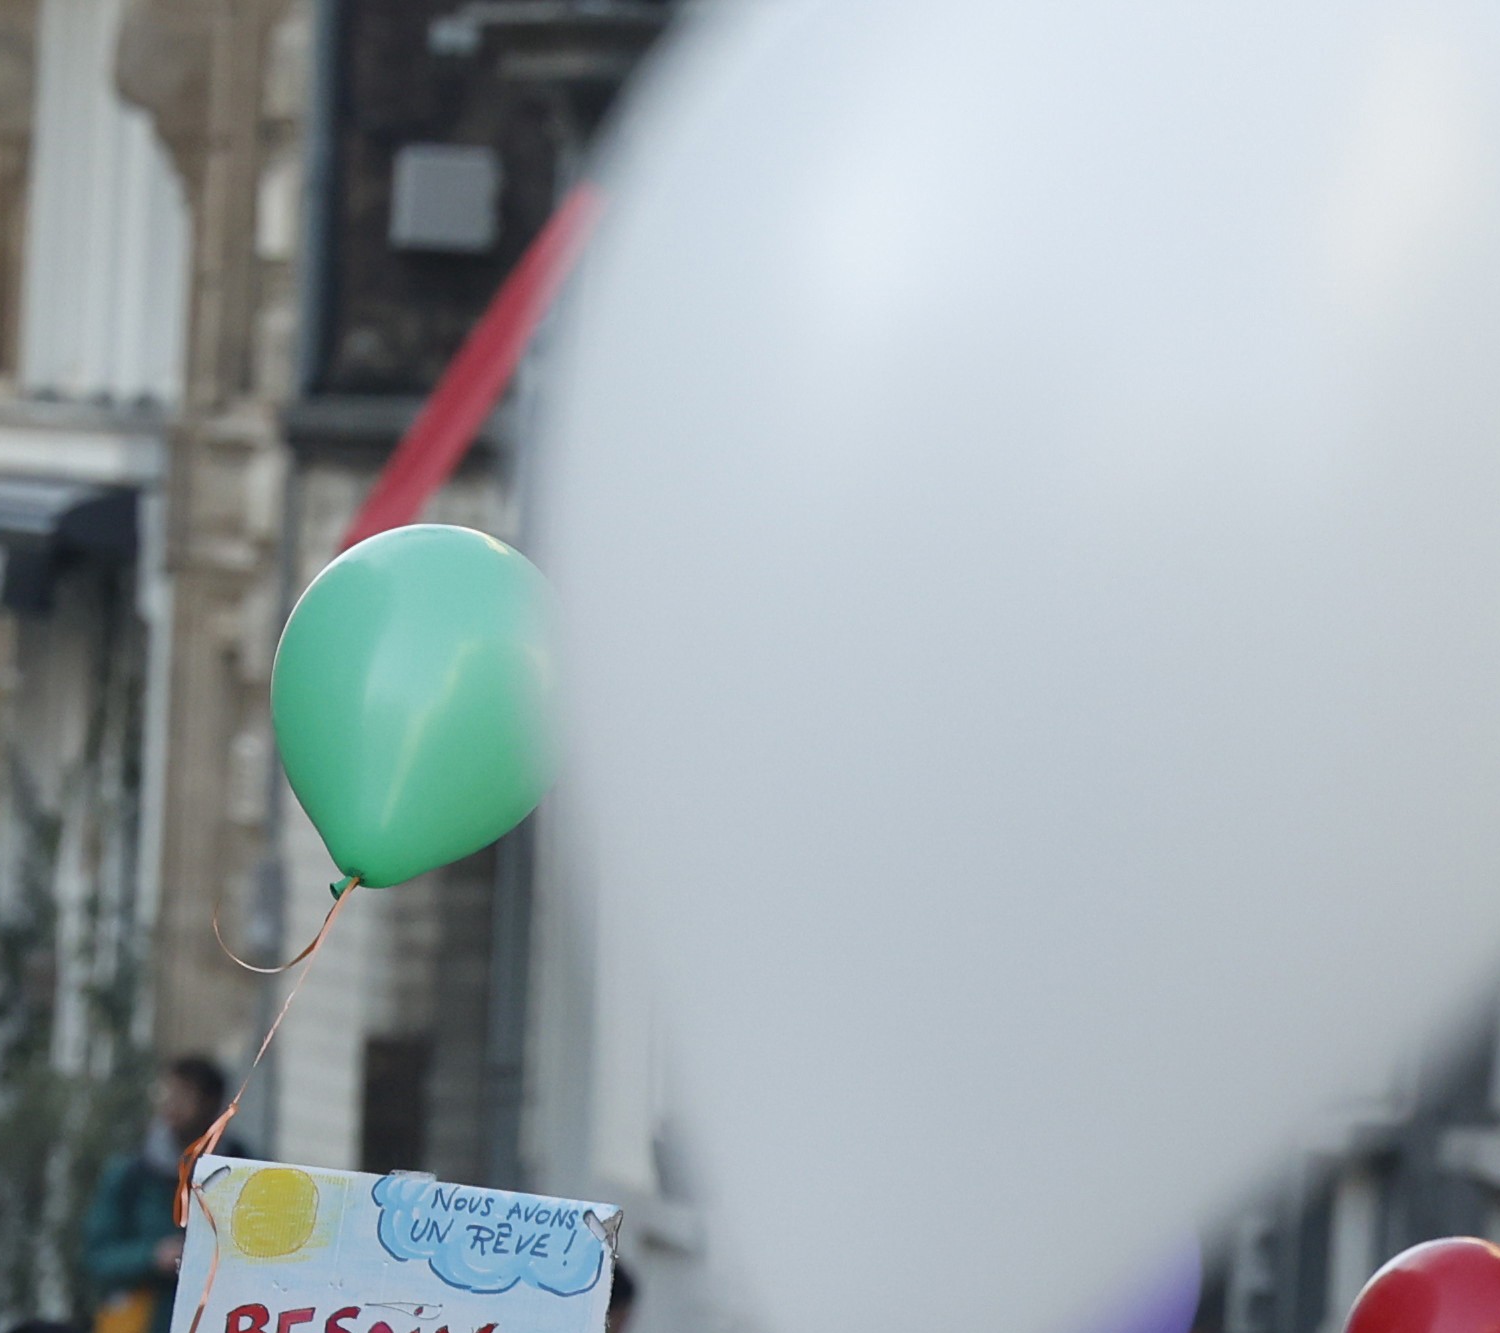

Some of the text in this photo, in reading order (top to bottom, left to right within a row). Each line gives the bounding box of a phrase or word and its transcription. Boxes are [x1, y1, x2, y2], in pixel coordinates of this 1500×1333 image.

[431, 1187, 579, 1230] NOUS AVONS
[410, 1218, 454, 1244] UN
[466, 1223, 551, 1258] RÊVE
